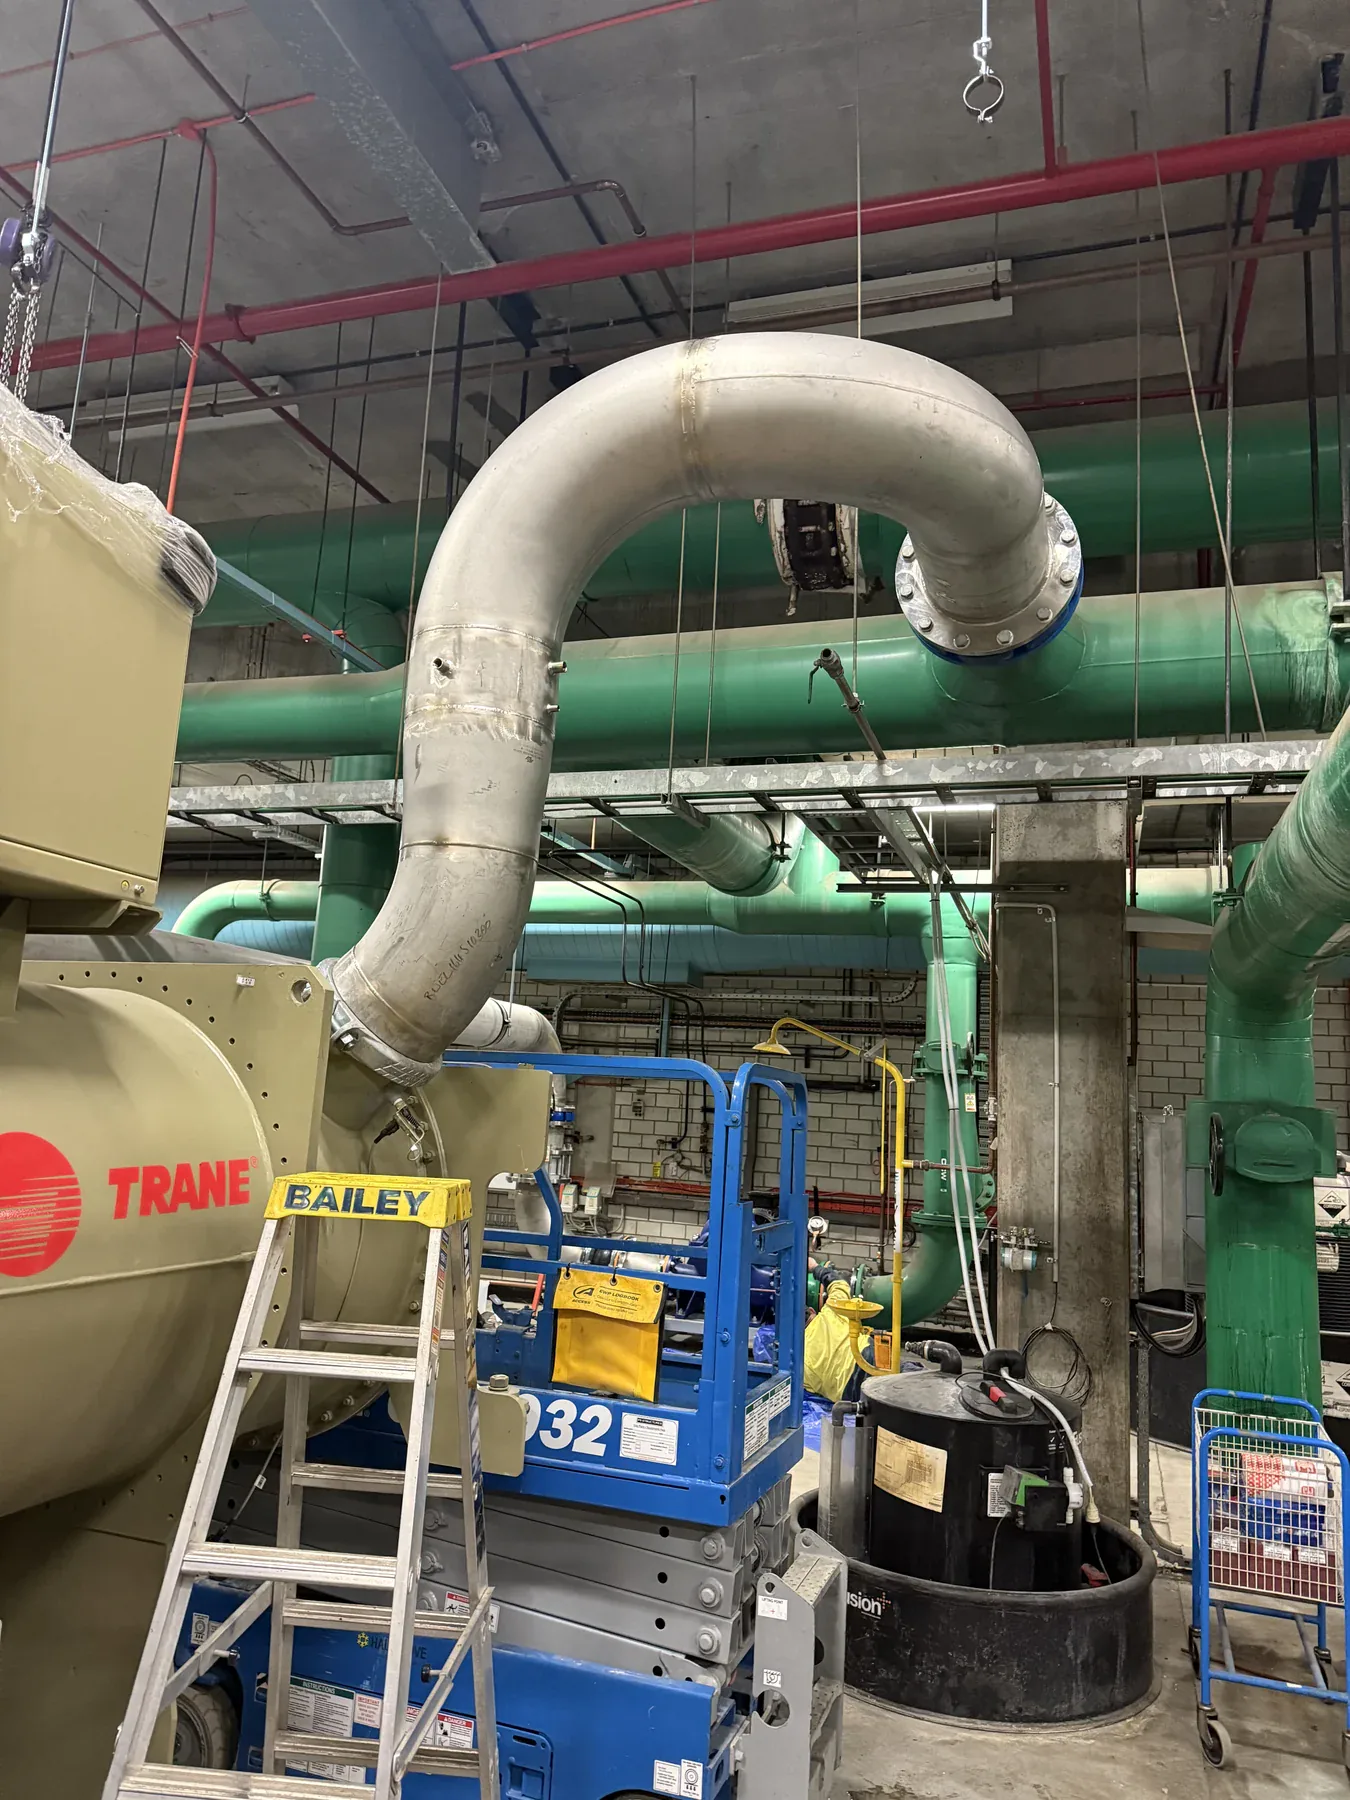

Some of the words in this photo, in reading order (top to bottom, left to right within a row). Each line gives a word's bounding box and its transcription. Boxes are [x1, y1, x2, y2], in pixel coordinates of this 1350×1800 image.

[108, 1158, 250, 1220] TRANE
[284, 1184, 432, 1217] BAILEY
[302, 1681, 336, 1695] INSTRUCTIONS
[447, 1717, 466, 1726] DANGER
